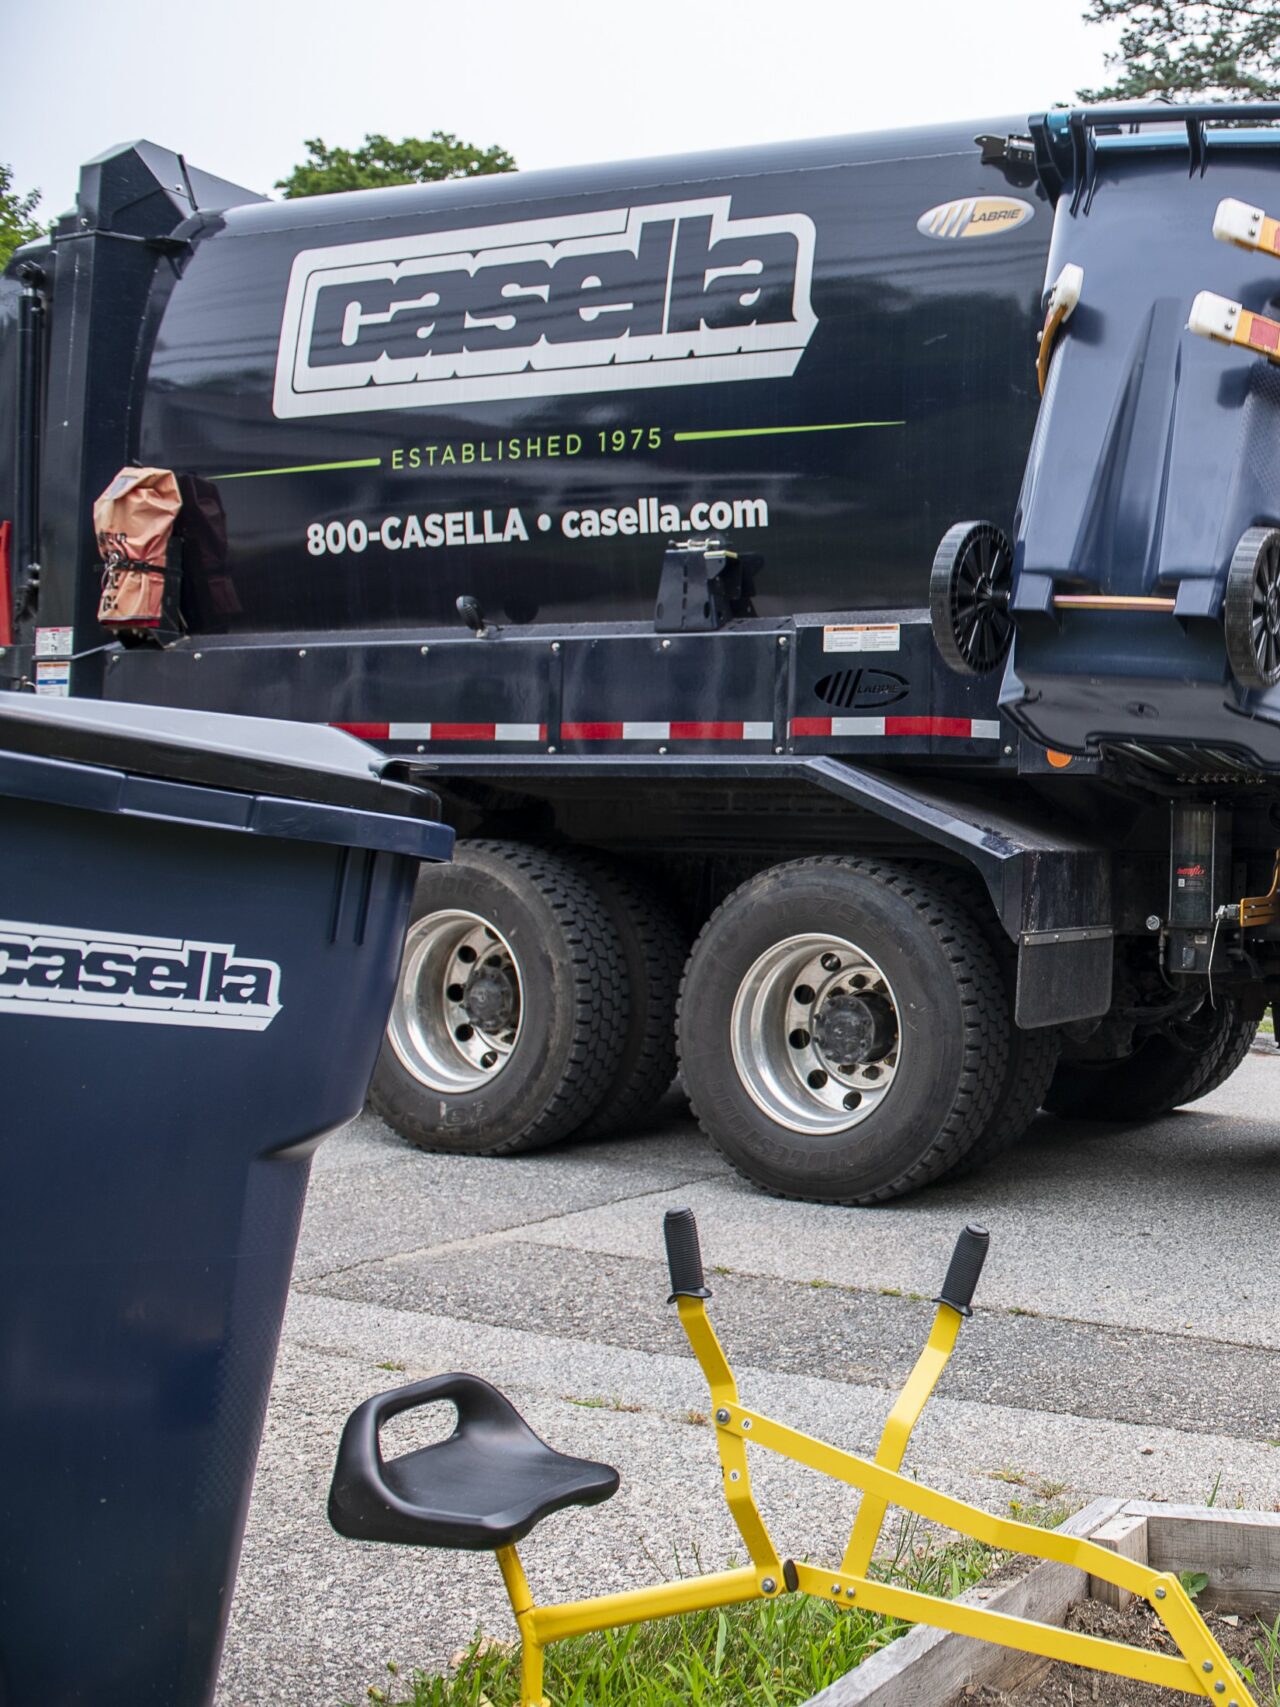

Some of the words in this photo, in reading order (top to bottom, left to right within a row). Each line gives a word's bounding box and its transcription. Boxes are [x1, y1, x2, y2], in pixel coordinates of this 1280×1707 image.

[970, 209, 1021, 223] LABRIE
[304, 211, 803, 373] casella
[392, 434, 582, 469] ESTABLISHED
[598, 427, 662, 452] 1975
[306, 508, 528, 556] 800-CASELLA
[561, 498, 769, 538] casella.com
